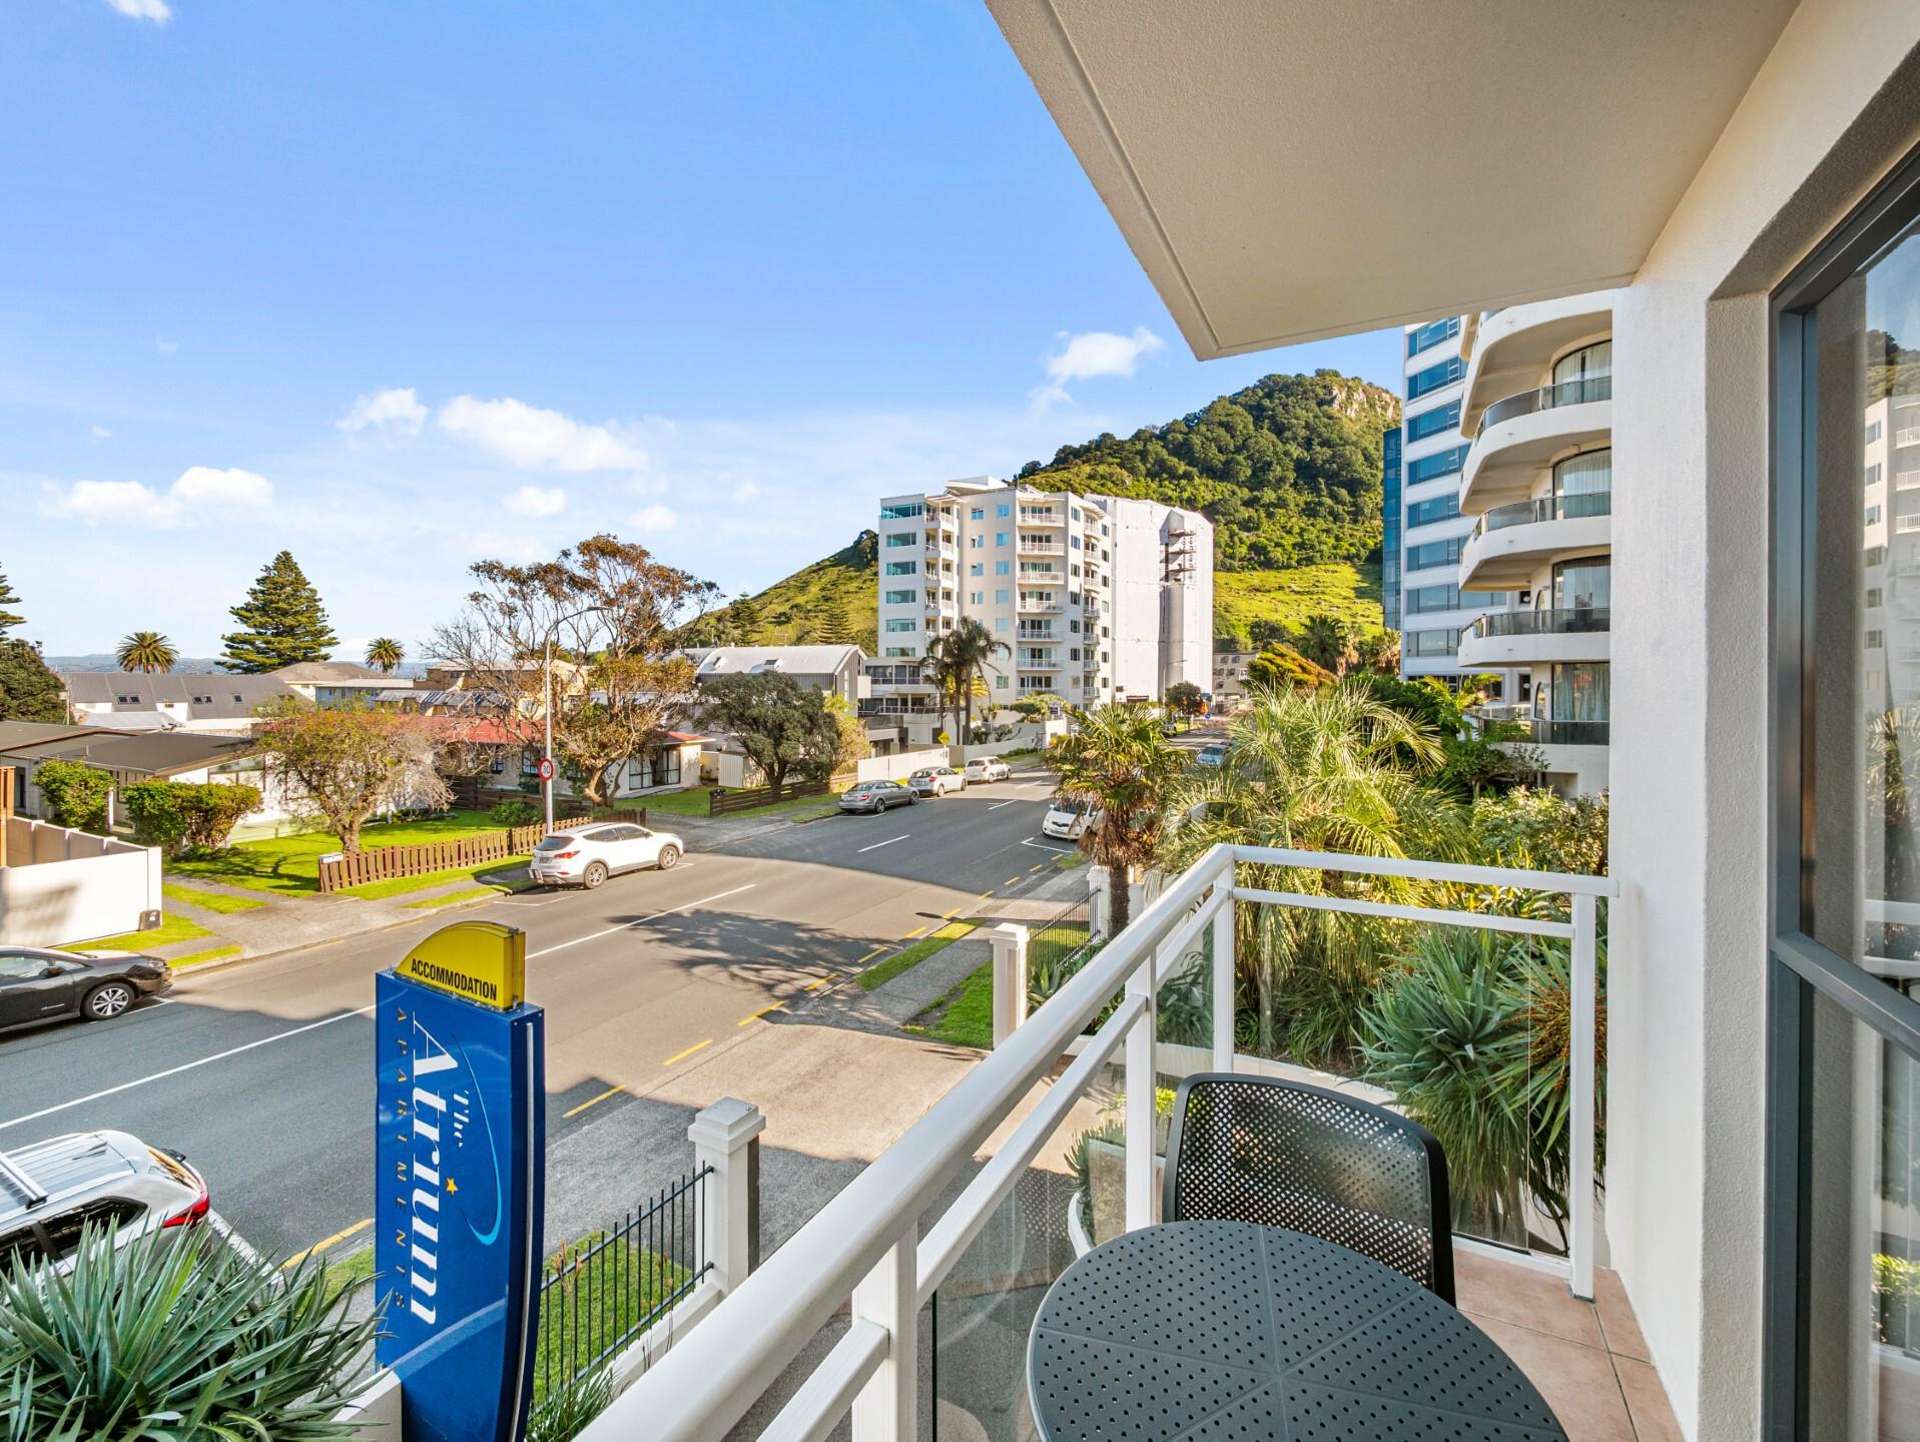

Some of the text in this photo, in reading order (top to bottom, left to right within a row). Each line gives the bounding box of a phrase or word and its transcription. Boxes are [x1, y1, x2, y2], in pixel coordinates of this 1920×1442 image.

[411, 958, 497, 1000] ACCOMMODATION
[396, 1008, 407, 1308] APARTMENTS
[411, 1011, 458, 1325] Atrium
[453, 1090, 469, 1148] The
